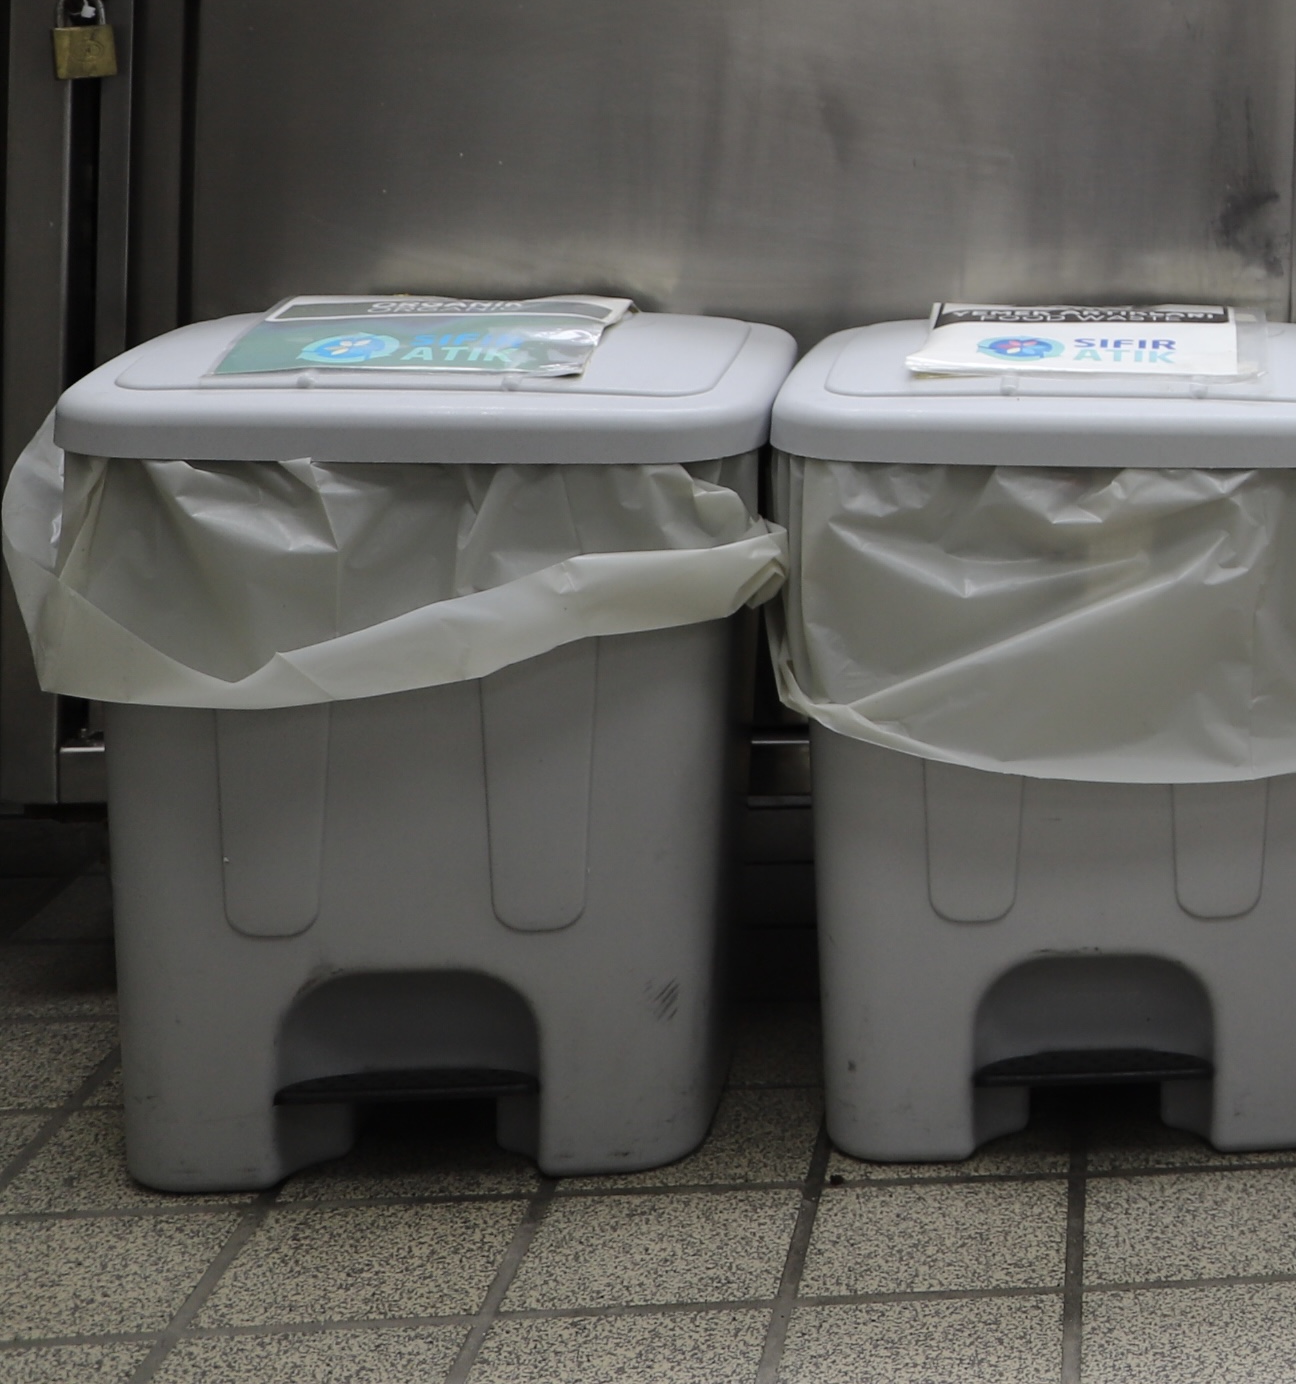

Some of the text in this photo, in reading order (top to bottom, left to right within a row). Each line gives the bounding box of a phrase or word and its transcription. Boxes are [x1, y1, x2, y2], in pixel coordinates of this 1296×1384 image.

[1074, 338, 1176, 350] SIFIR
[400, 346, 519, 363] ATIK
[1073, 349, 1177, 364] ATIK
